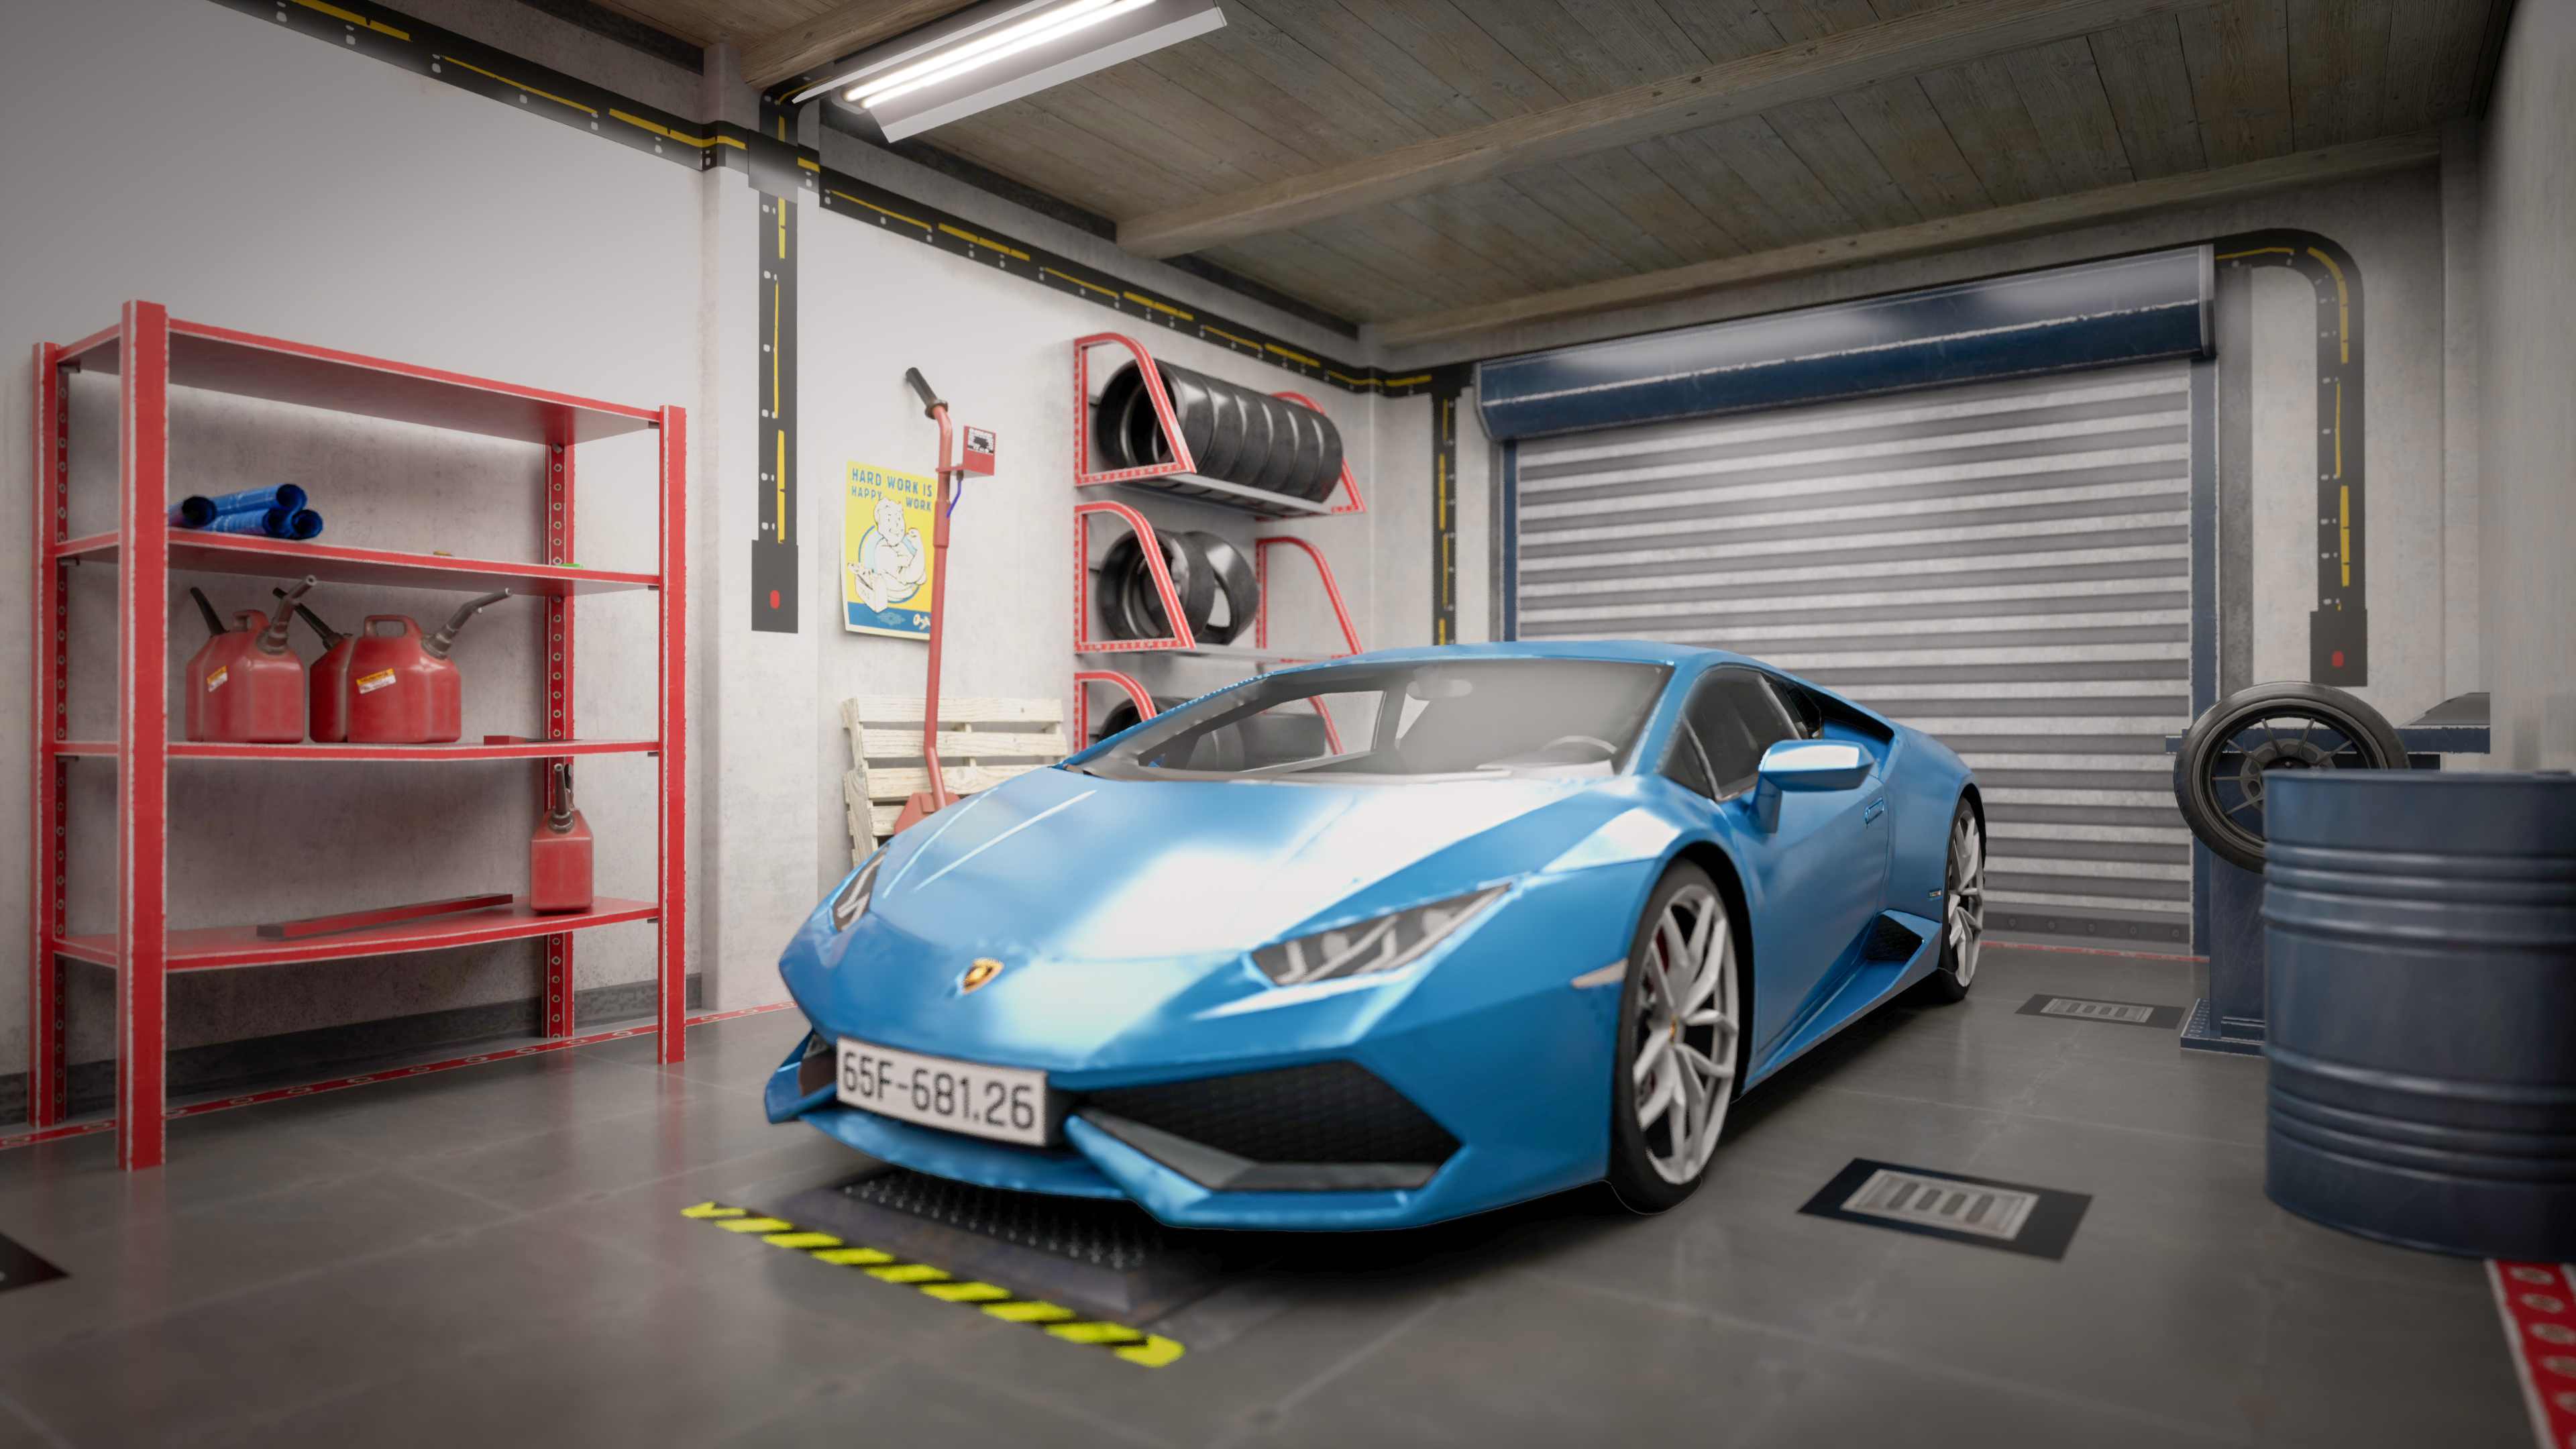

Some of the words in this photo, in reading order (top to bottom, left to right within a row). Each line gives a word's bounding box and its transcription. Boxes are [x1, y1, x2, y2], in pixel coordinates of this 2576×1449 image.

[852, 468, 881, 486] HARD
[887, 476, 918, 494] WORK
[923, 484, 932, 497] IS
[852, 486, 882, 500] HAPPY
[906, 497, 931, 511] WORK
[843, 1051, 1035, 1130] 65F-681.26
